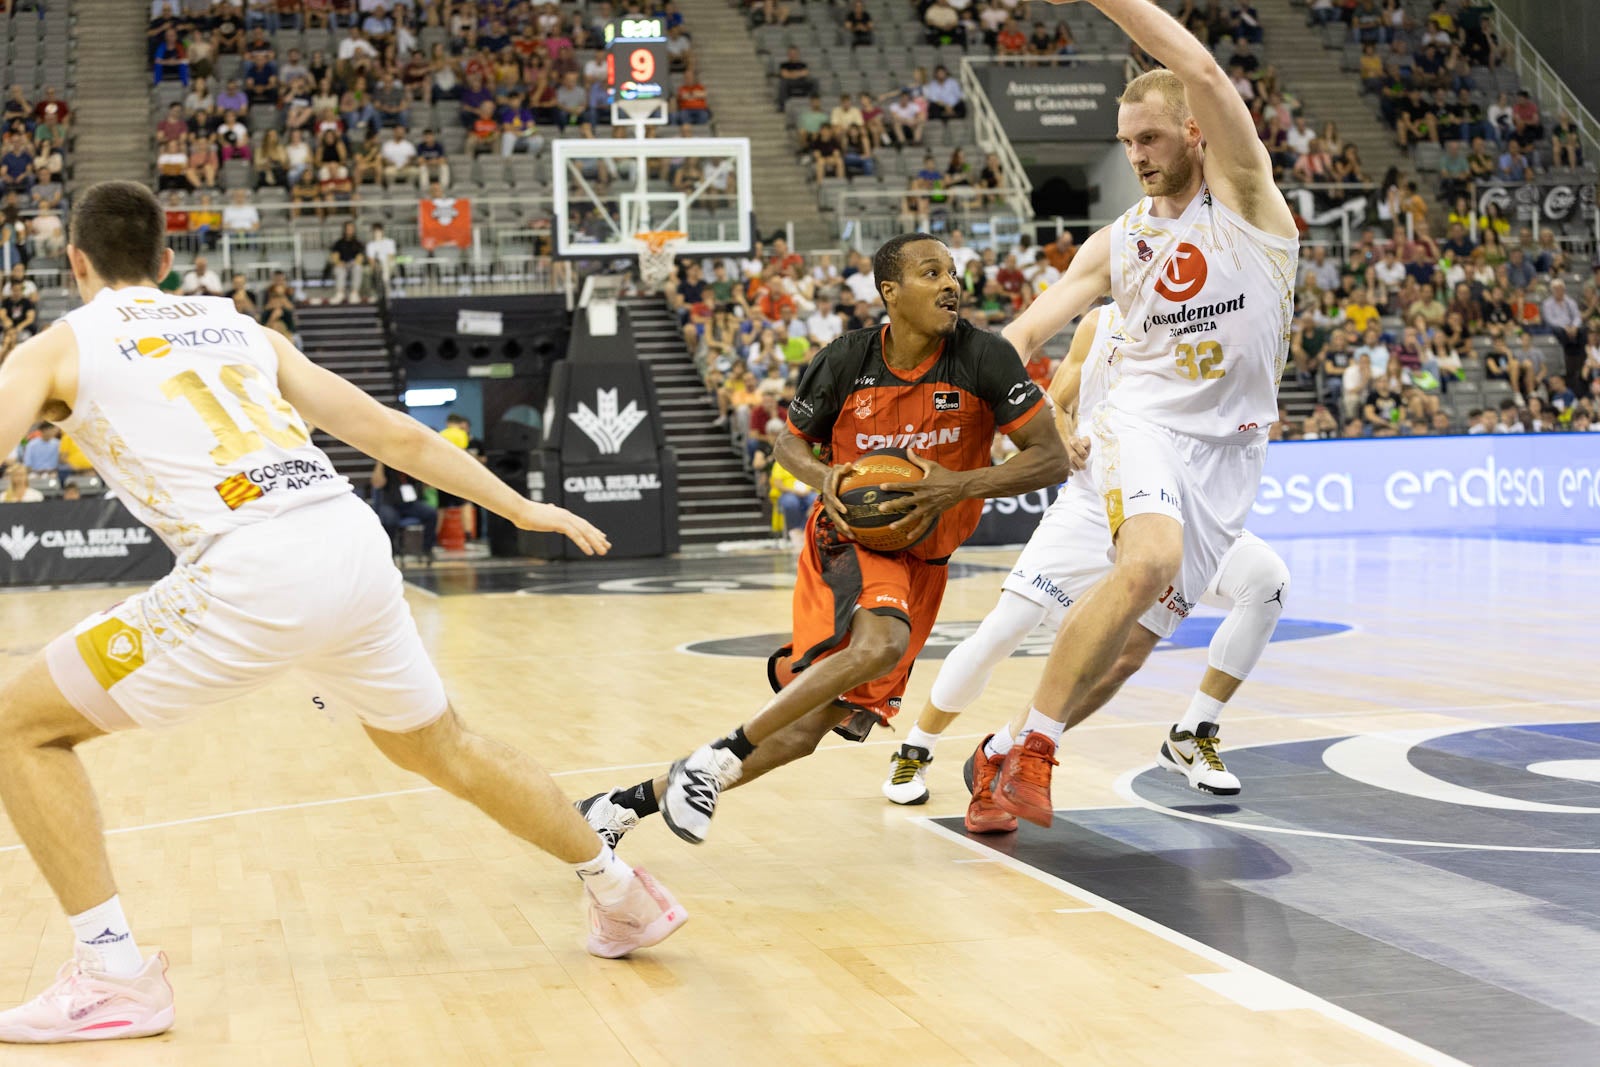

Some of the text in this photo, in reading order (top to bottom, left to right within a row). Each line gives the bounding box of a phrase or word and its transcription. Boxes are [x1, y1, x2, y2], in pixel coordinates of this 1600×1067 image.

[629, 48, 655, 83] 9
[1143, 293, 1246, 334] Casademont
[118, 327, 249, 361] HORIZONT
[1174, 340, 1226, 380] 32
[855, 424, 961, 451] COVIRAN
[564, 476, 604, 492] CAJA
[605, 473, 661, 491] RURAL
[1385, 455, 1545, 510] endesa
[40, 526, 152, 548] CAJA RURAL
[1032, 573, 1074, 607] hiberus
